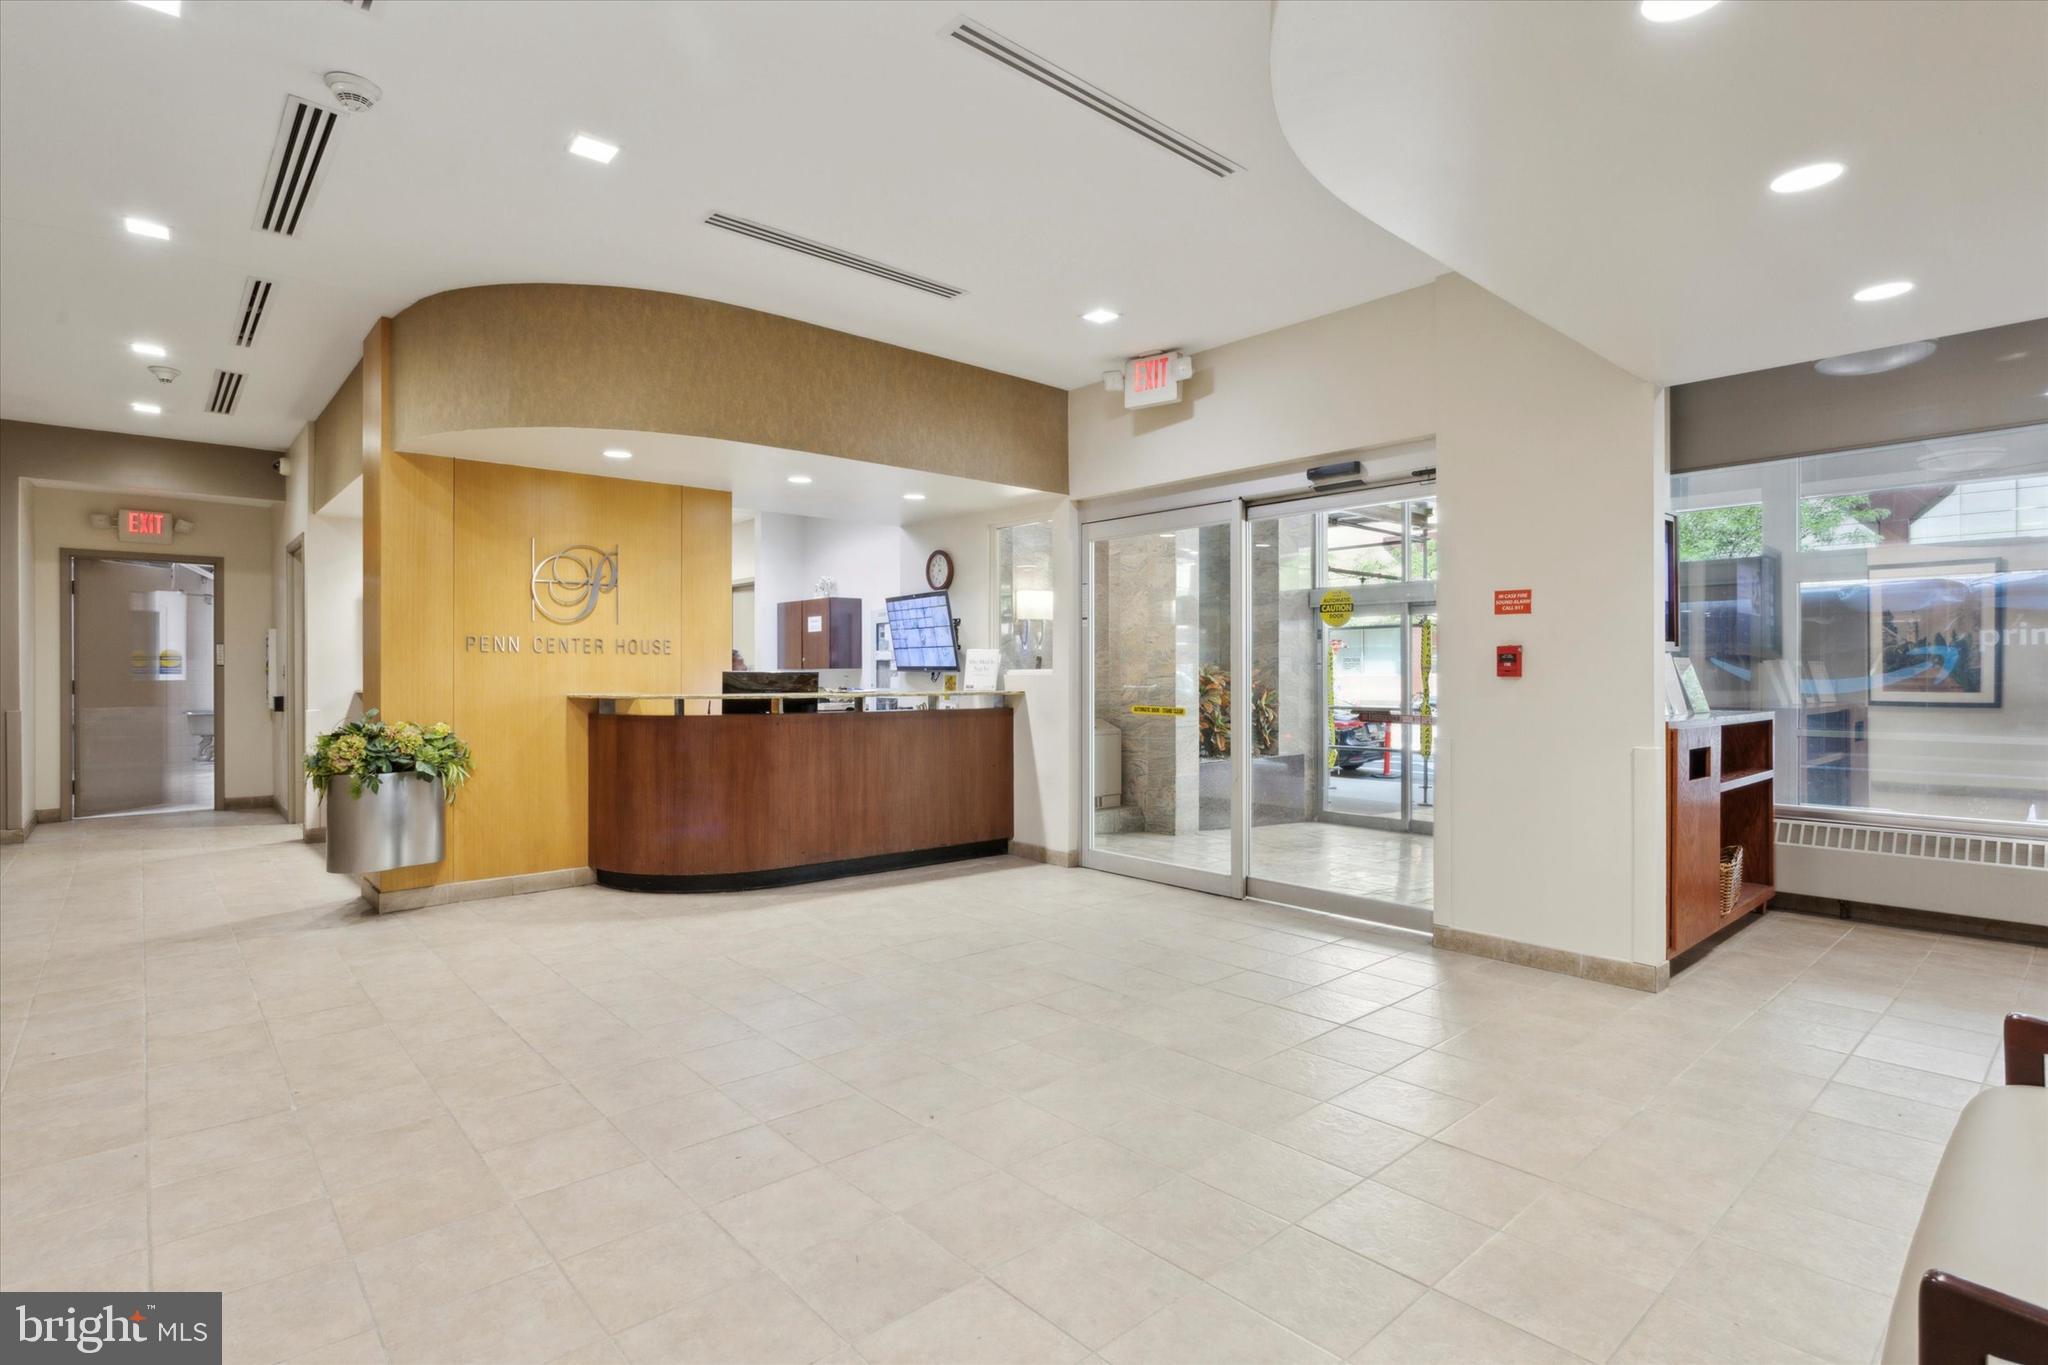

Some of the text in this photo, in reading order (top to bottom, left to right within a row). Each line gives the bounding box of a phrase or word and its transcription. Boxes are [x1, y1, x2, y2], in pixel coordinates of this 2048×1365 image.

[1135, 357, 1169, 393] EXIT
[128, 511, 164, 536] EXIT
[1321, 603, 1352, 612] CAUTION
[465, 634, 673, 656] PENN CENTER HOUSE
